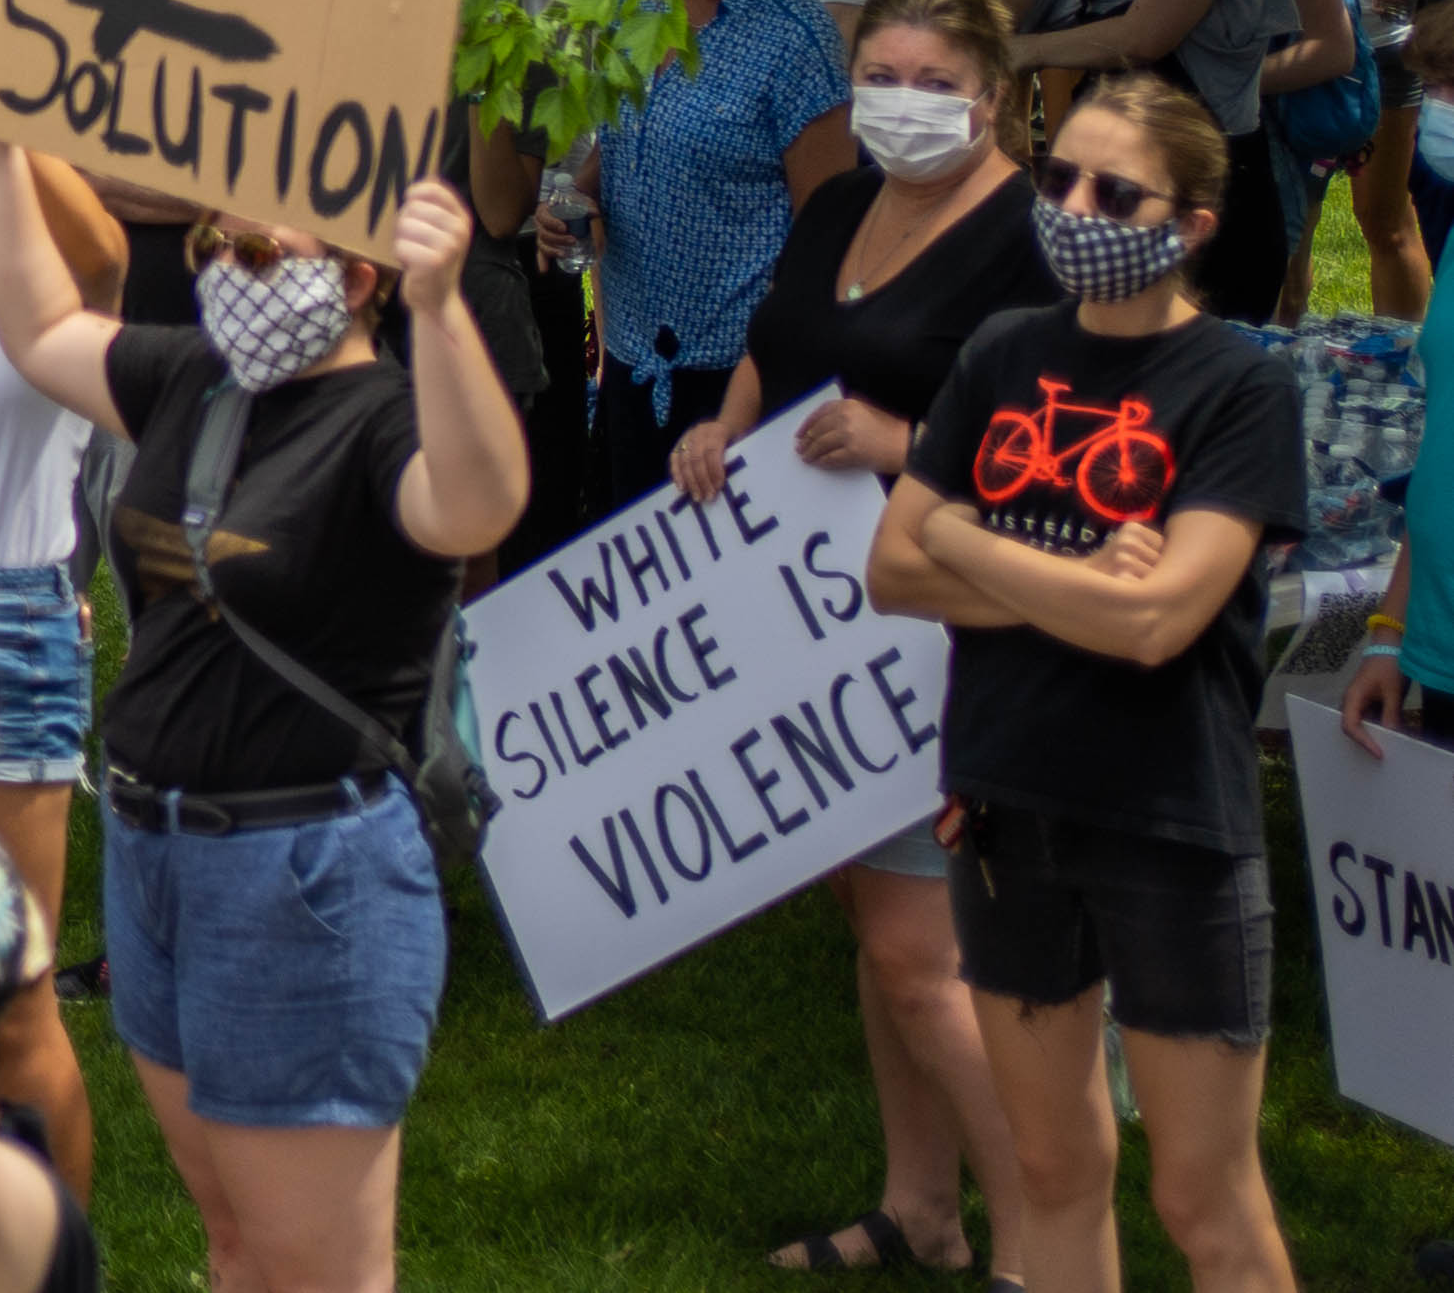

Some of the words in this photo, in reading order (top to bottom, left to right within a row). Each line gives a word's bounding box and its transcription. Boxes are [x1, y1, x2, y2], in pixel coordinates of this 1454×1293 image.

[492, 602, 739, 802] SILENCE
[778, 529, 866, 642] IS
[547, 455, 781, 636] WHITE
[566, 645, 941, 920] VIOLENCE
